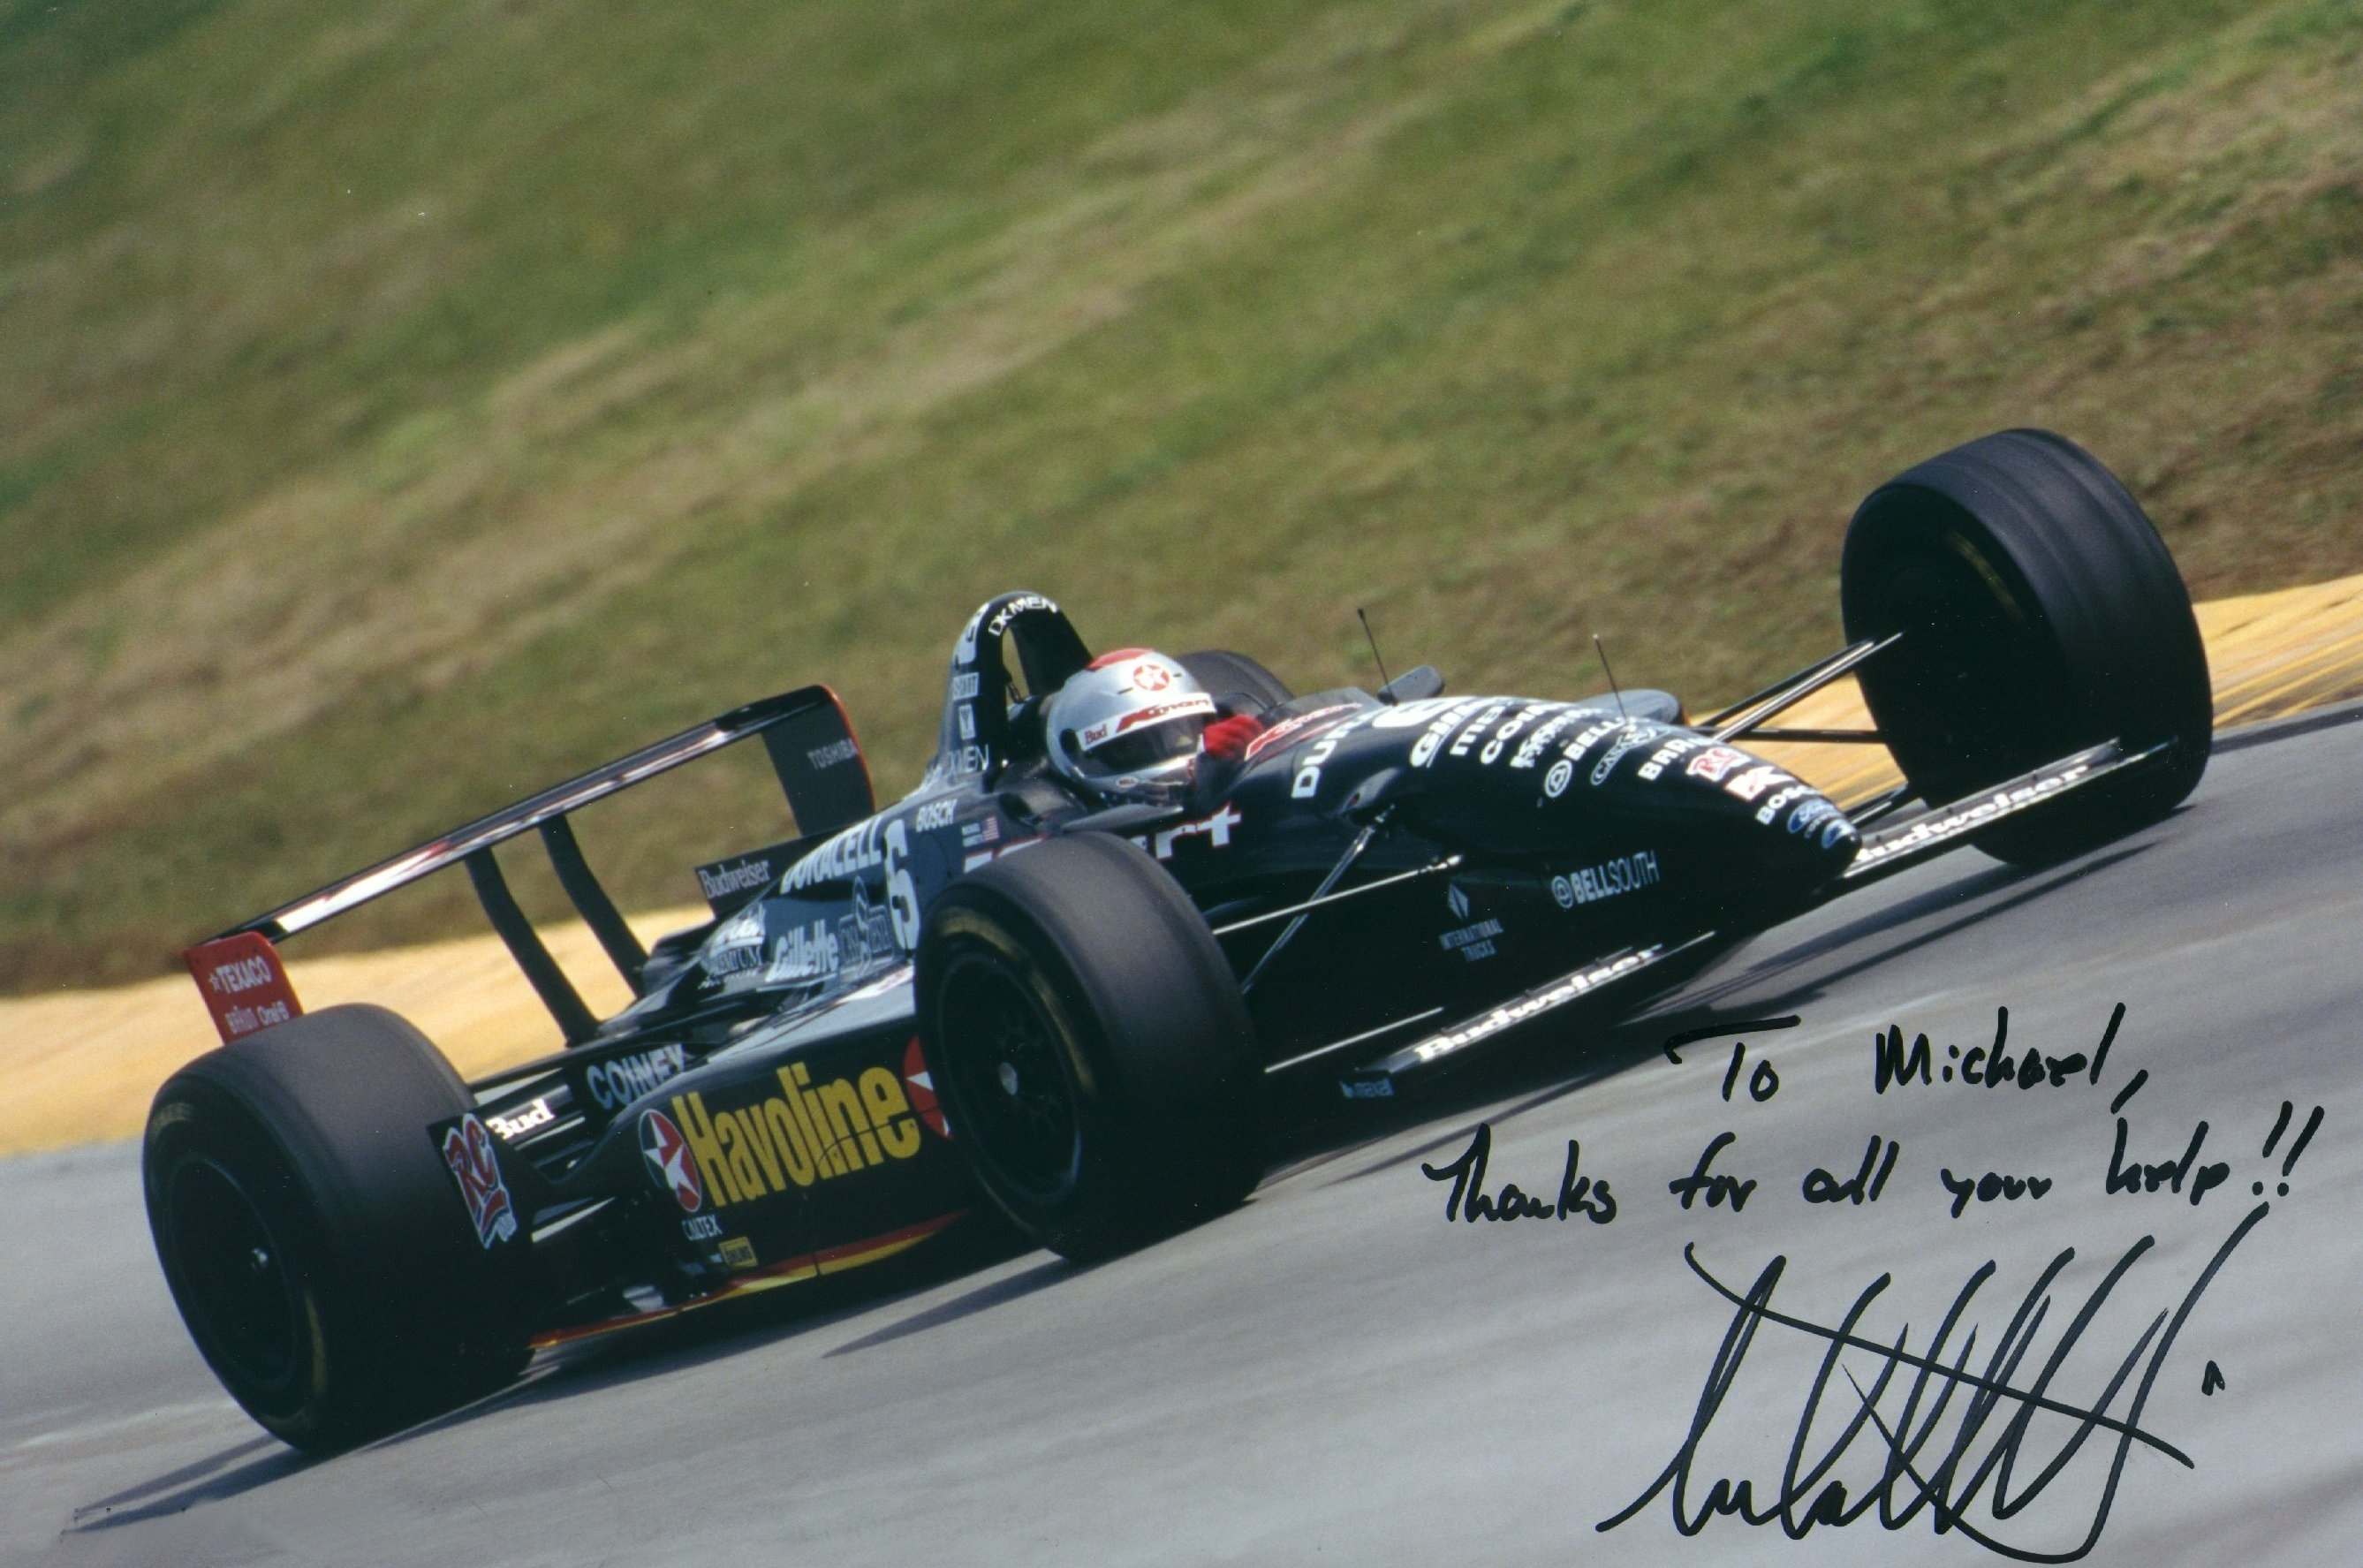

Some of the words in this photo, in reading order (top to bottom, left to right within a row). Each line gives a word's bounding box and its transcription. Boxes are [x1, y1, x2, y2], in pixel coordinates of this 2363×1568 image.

[915, 799, 958, 833] BOSCH
[698, 859, 770, 899] Budweiser
[884, 819, 920, 951] 6
[216, 955, 272, 994] TEXACO
[765, 919, 839, 983] Gillette
[1415, 943, 1663, 1062] Budweiser
[1664, 1014, 1802, 1102] To
[486, 1097, 556, 1140] Bud
[670, 1061, 921, 1208] Havoline
[1421, 1122, 1618, 1224] Thanks
[1668, 1132, 1758, 1213] for
[1800, 1134, 1900, 1206] all
[1940, 1167, 2053, 1219] your
[681, 1214, 723, 1241] CALTEX
